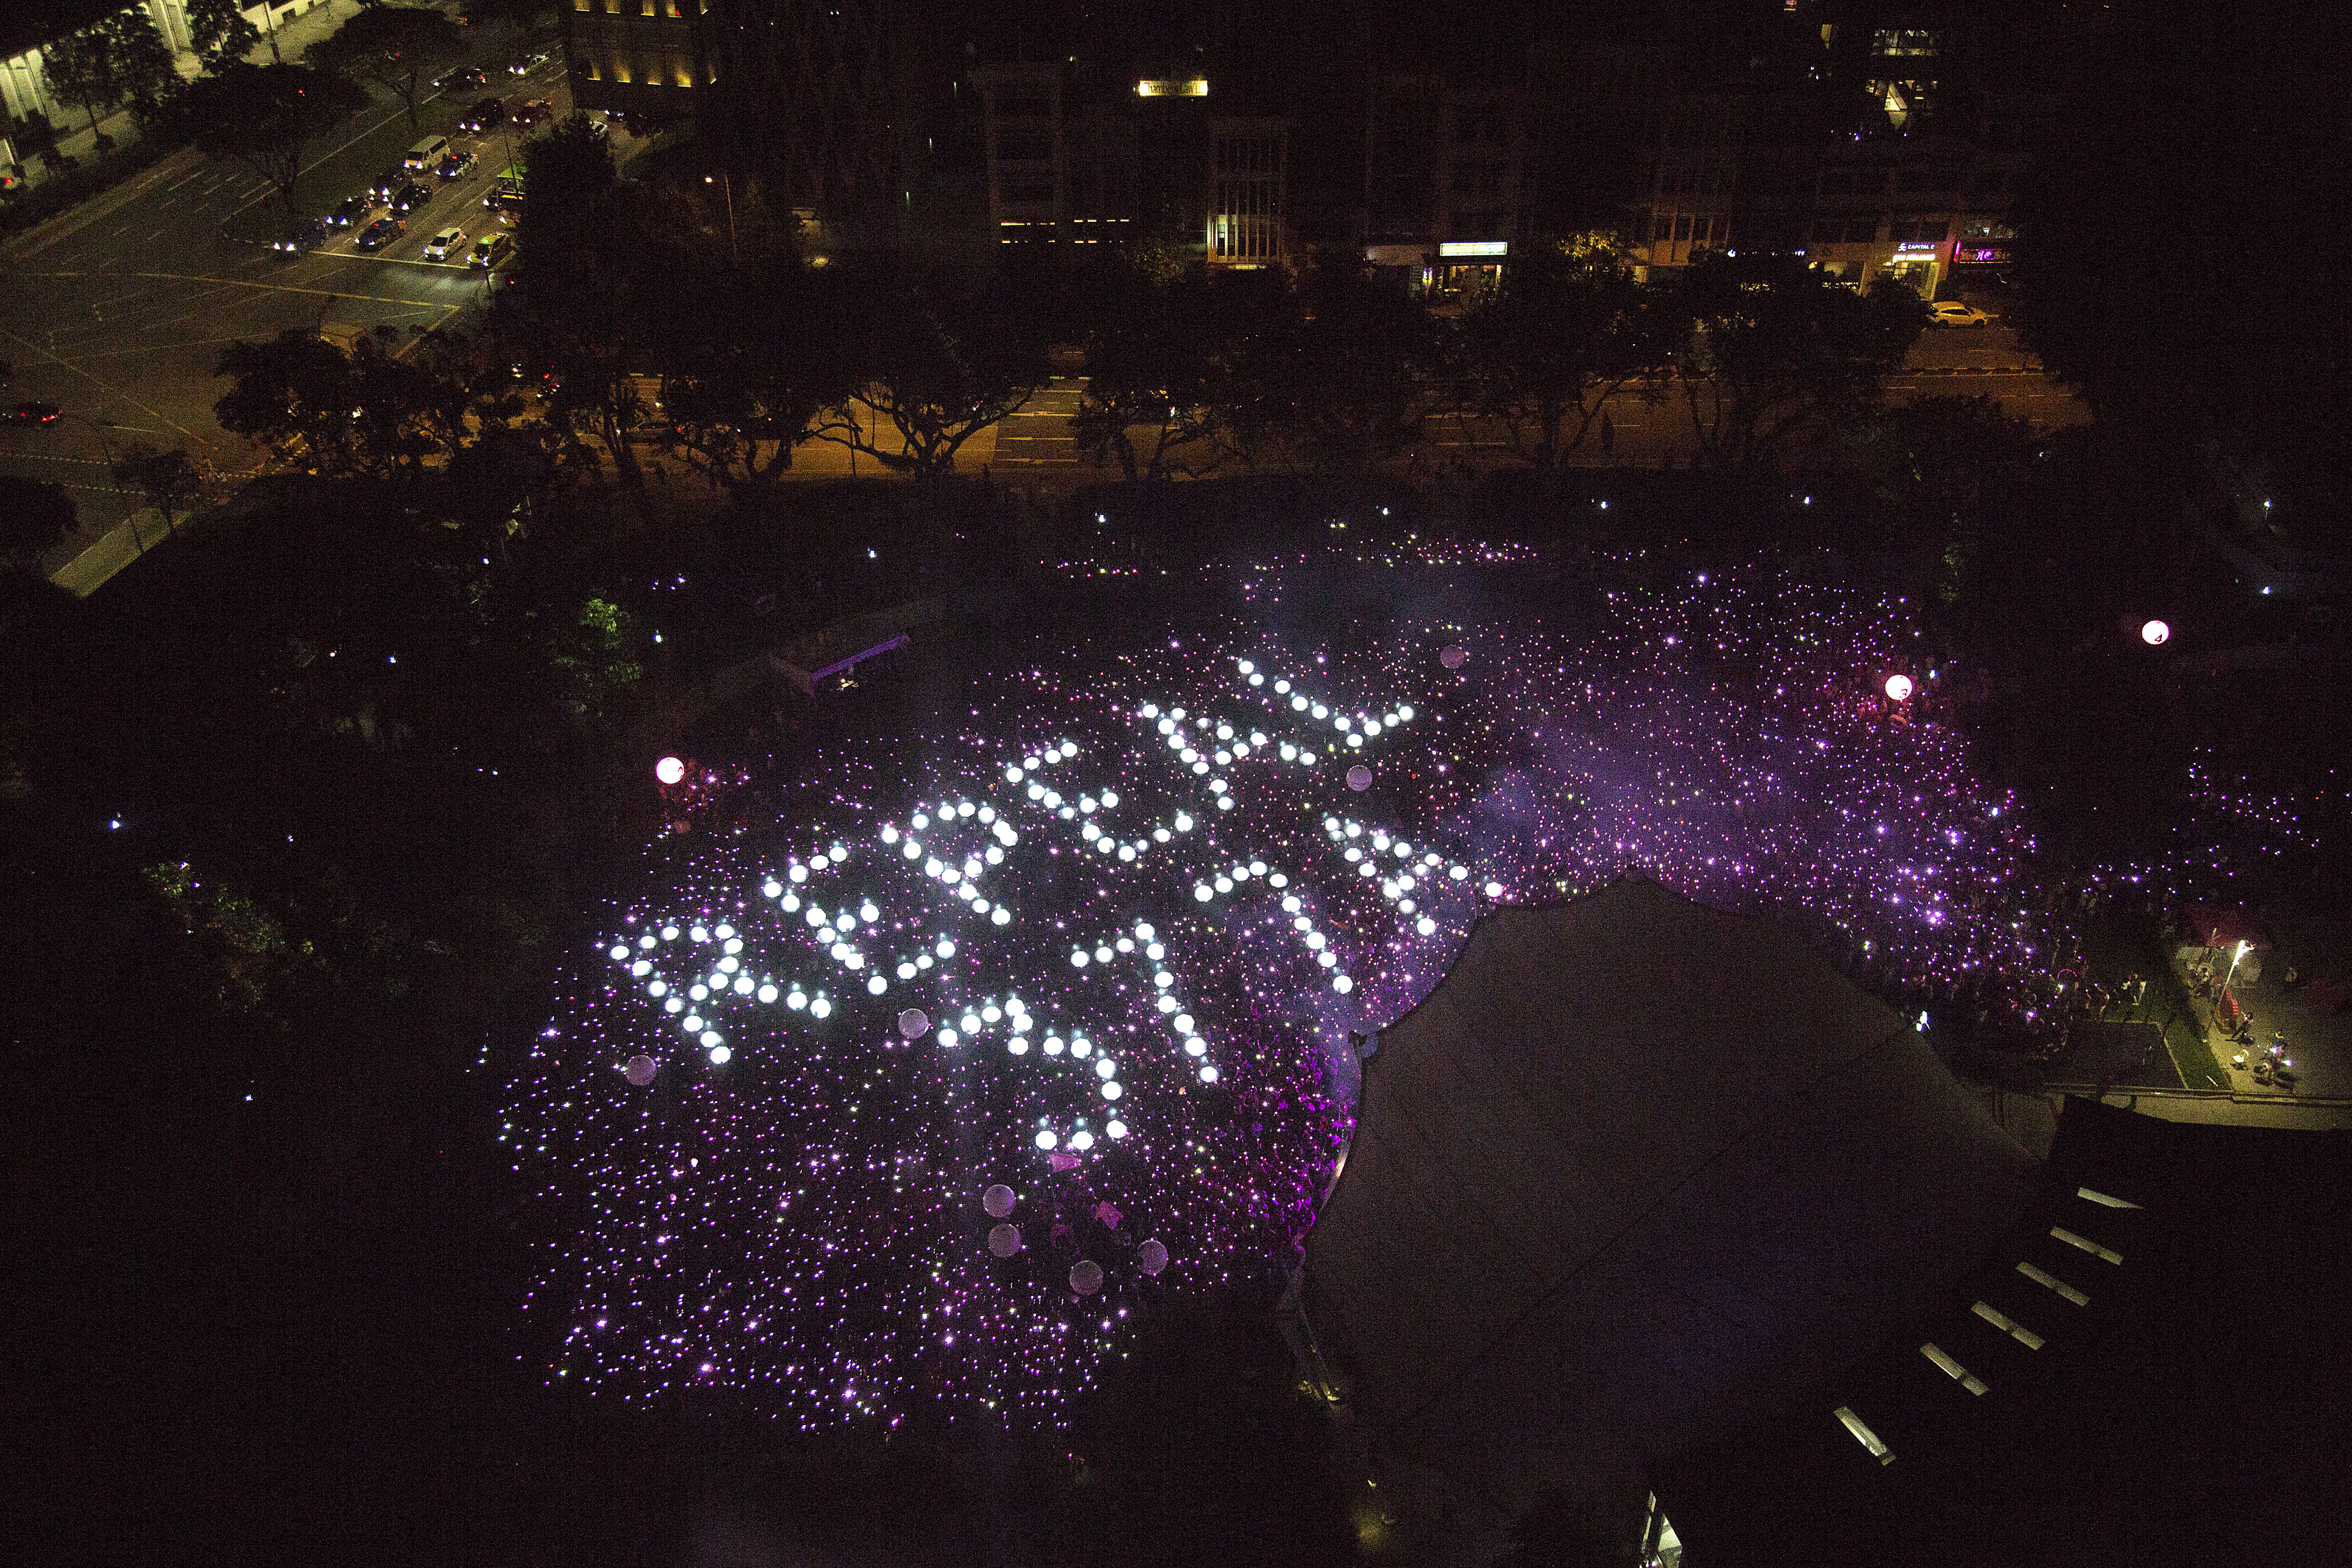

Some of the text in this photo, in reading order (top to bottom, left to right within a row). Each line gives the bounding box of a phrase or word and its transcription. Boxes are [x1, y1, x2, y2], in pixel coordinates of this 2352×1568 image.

[1442, 245, 1478, 253] HICKORY
[609, 657, 1416, 1067] REPEAL
[936, 814, 1503, 1151] 377A
